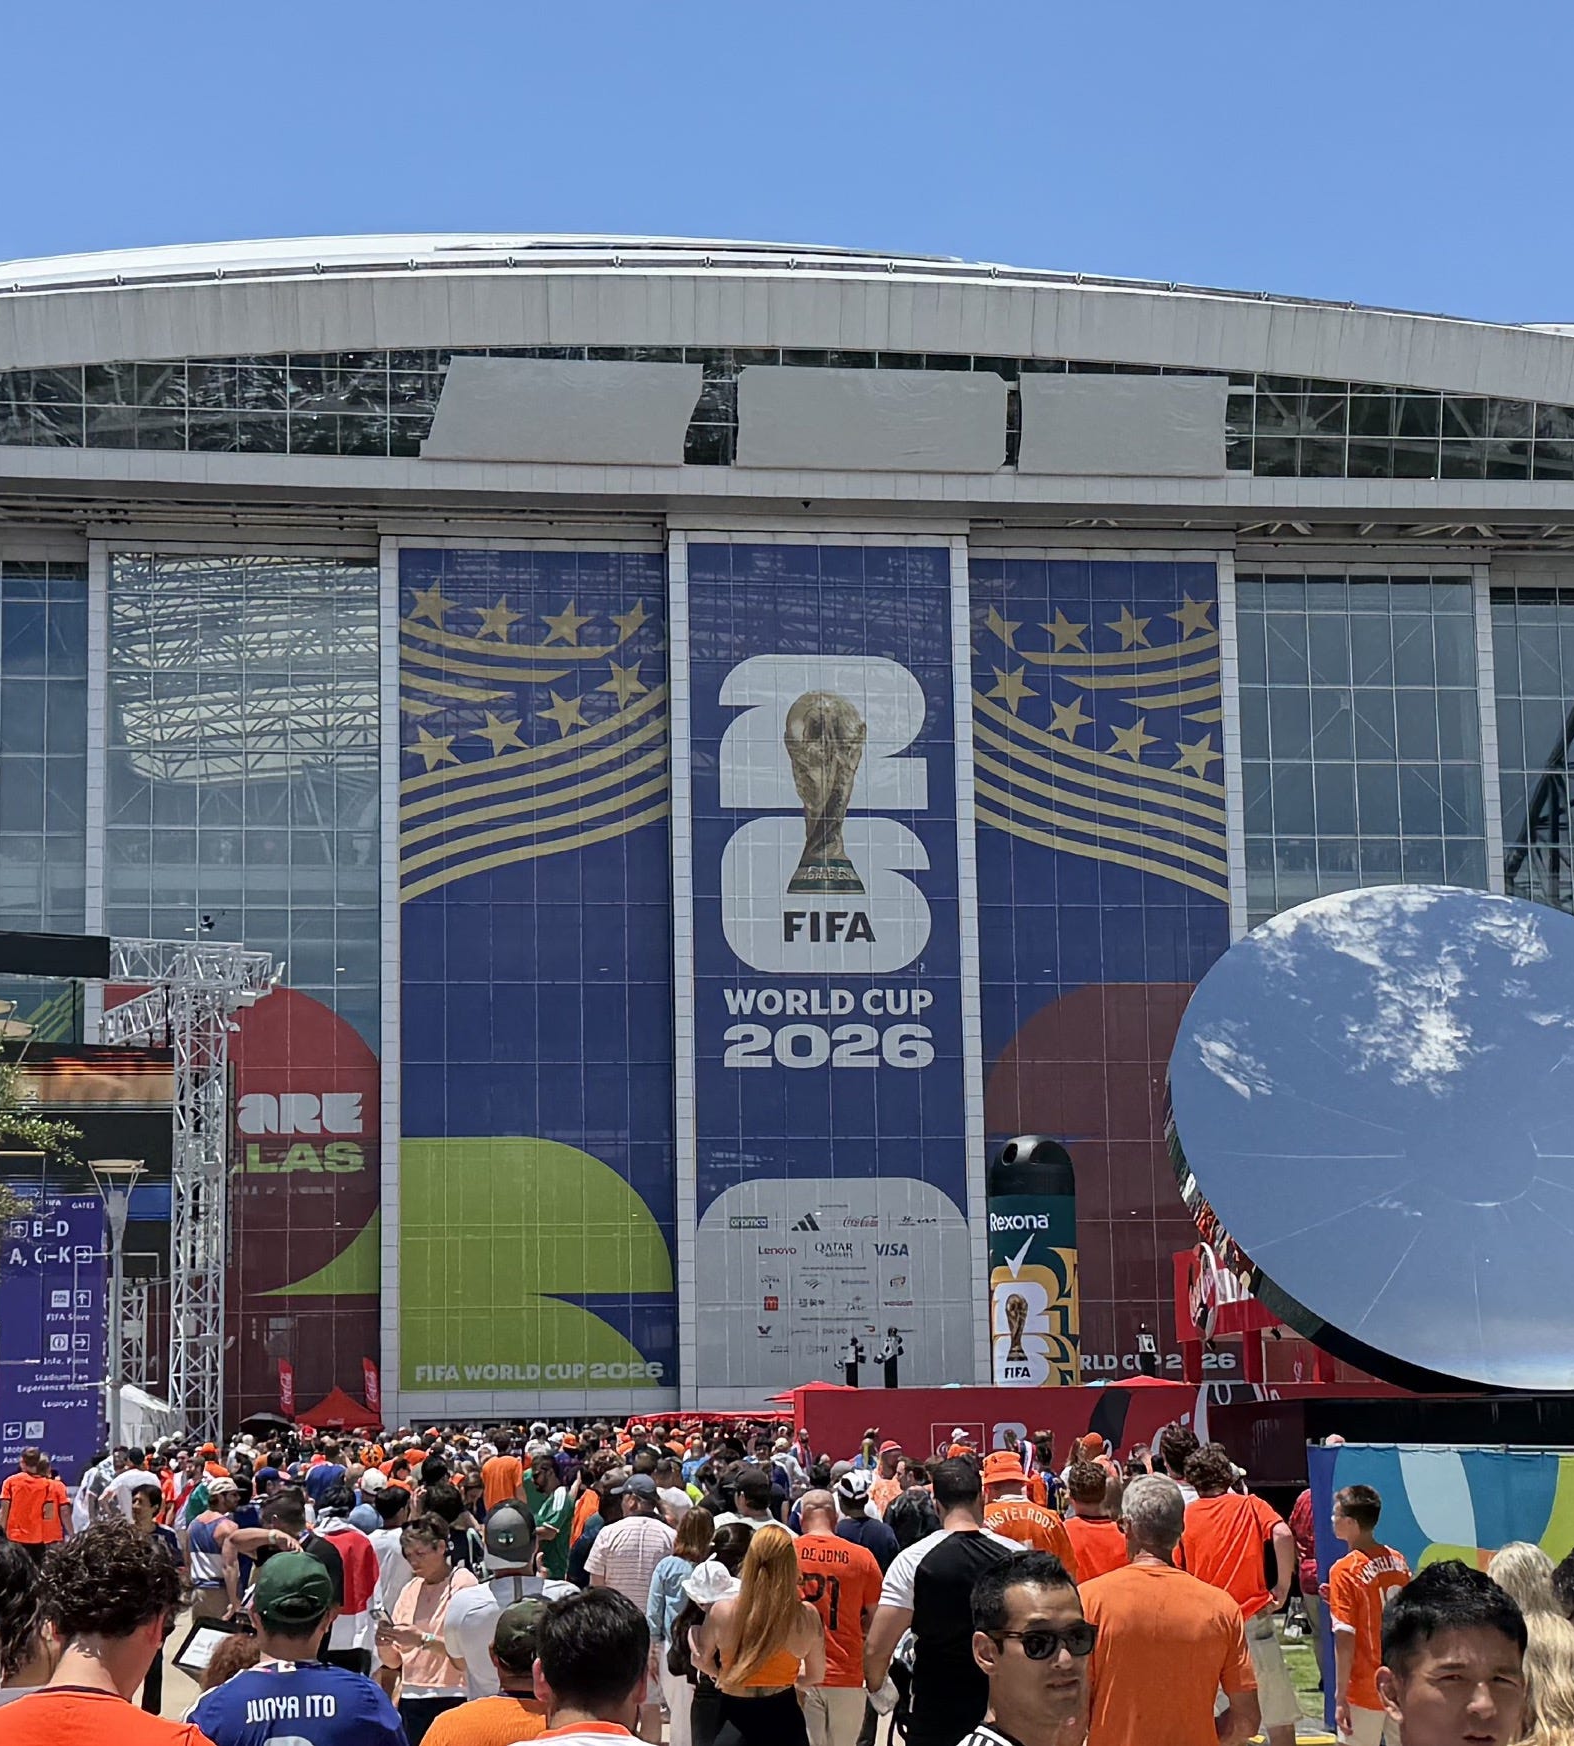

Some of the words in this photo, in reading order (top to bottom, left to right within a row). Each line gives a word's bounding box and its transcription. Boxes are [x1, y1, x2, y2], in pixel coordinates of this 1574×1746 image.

[783, 911, 876, 942] FIFA
[723, 988, 855, 1016] WORLD
[862, 988, 934, 1016] CUP
[723, 1023, 935, 1069] 2026
[989, 1212, 1049, 1232] Rexona
[9, 1248, 27, 1266] A,
[758, 1245, 797, 1255] Lenovo
[814, 1242, 853, 1254] QATAR
[874, 1243, 909, 1256] VISA
[68, 1313, 90, 1321] Sore
[1165, 1353, 1236, 1370] 226
[415, 1364, 459, 1382] FIFA
[463, 1363, 541, 1381] WORLD
[544, 1363, 585, 1381] CUP
[589, 1361, 664, 1379] 2026
[1005, 1368, 1031, 1379] FIFA
[801, 1547, 817, 1561] DE
[818, 1549, 850, 1565] JONG
[246, 1695, 300, 1724] JUNYA
[305, 1694, 336, 1718] ITO
